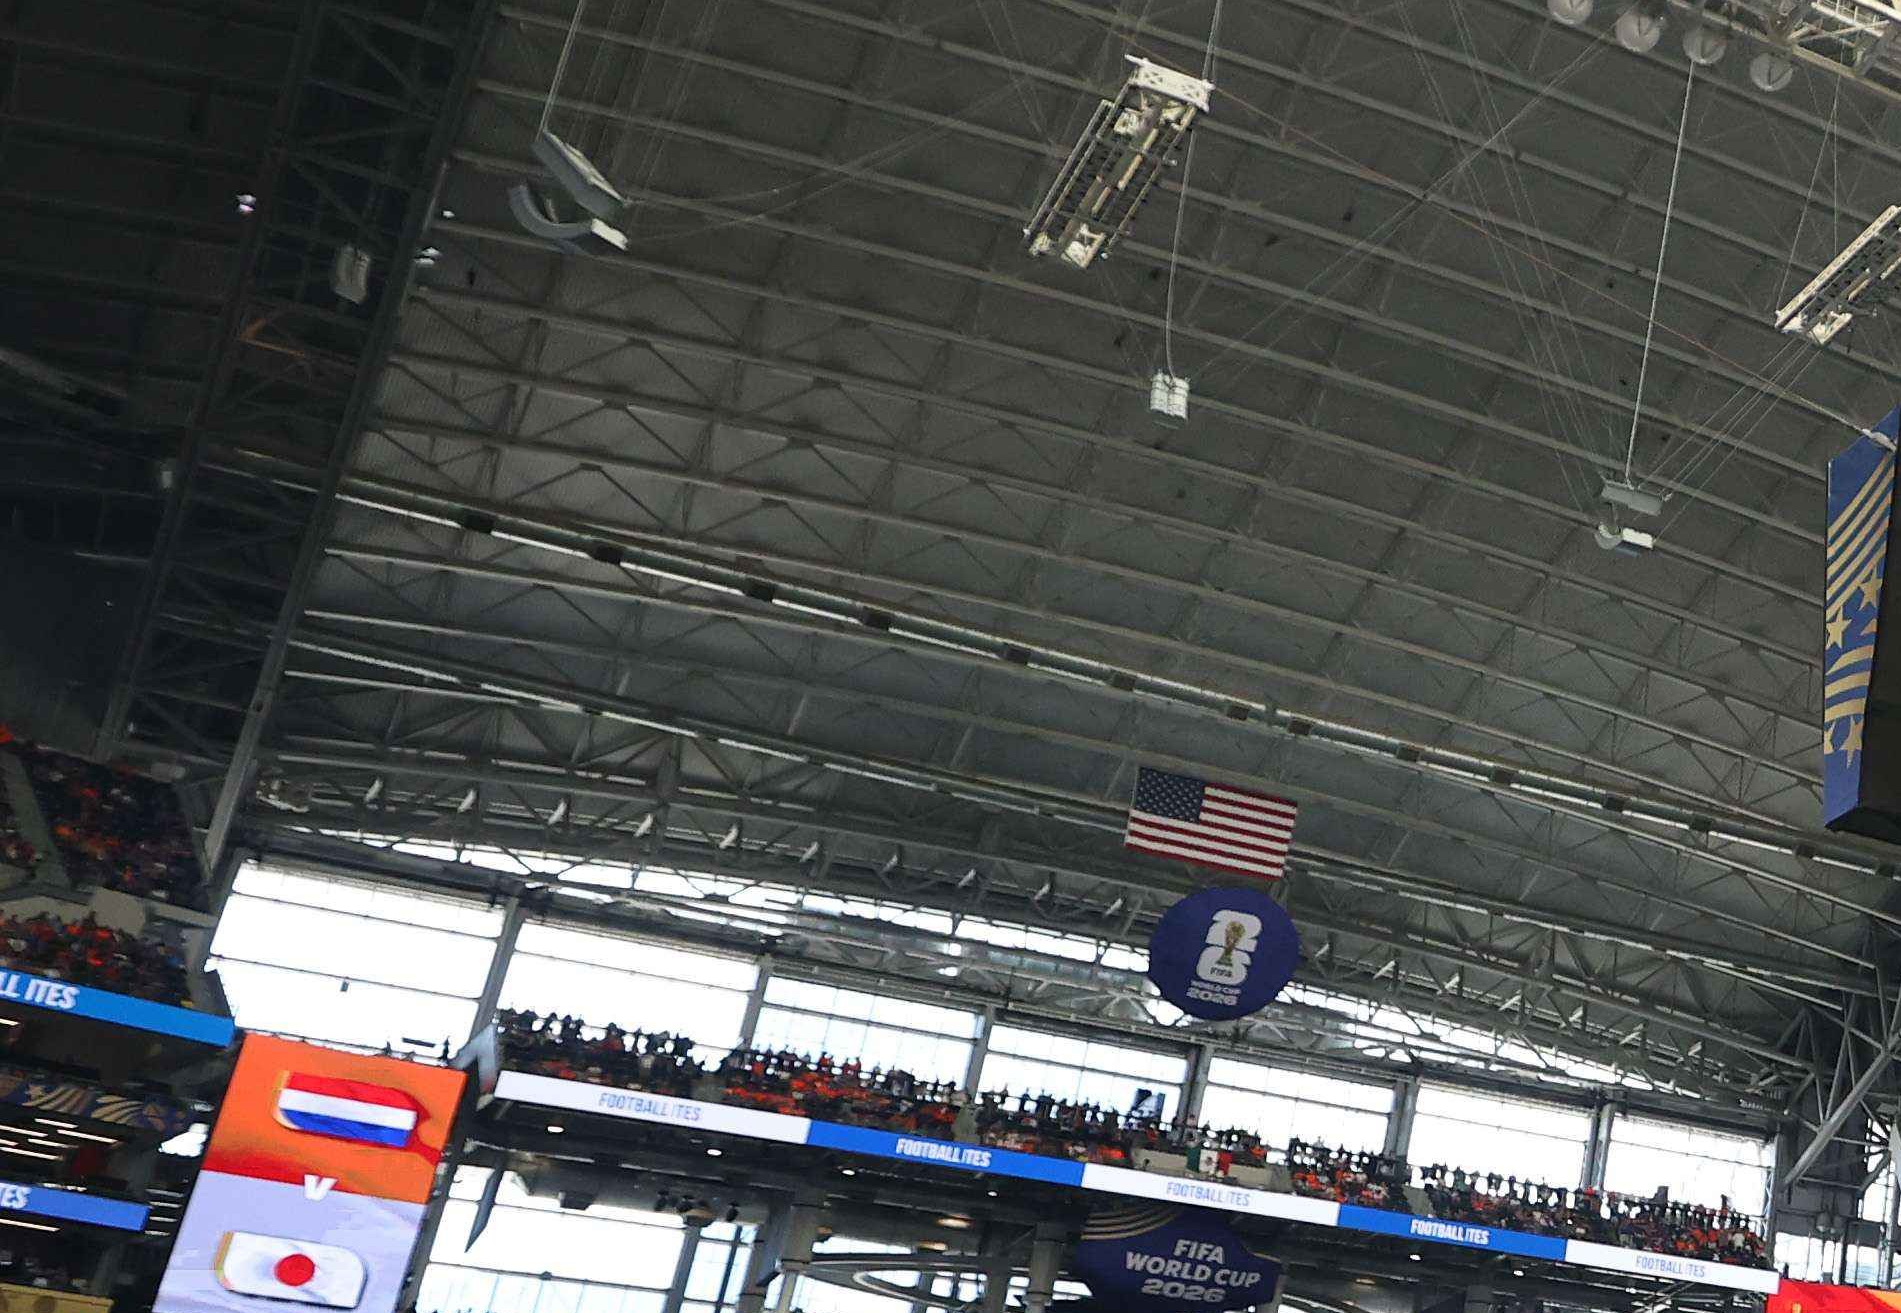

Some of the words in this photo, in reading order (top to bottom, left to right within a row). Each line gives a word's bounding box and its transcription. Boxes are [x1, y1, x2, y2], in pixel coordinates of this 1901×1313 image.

[1186, 987, 1239, 1006] 2026
[599, 1094, 668, 1119] FOOTBALL
[897, 1139, 959, 1162] FOOTBALL
[1167, 1180, 1222, 1201] FOOTBALL
[1411, 1220, 1463, 1240] FOOTBALL
[1173, 1239, 1225, 1265] FIFA
[1126, 1251, 1211, 1282] WORLD
[1215, 1268, 1261, 1288] CUP
[1636, 1256, 1682, 1274] FOOTBALL
[1142, 1278, 1226, 1303] 2026
